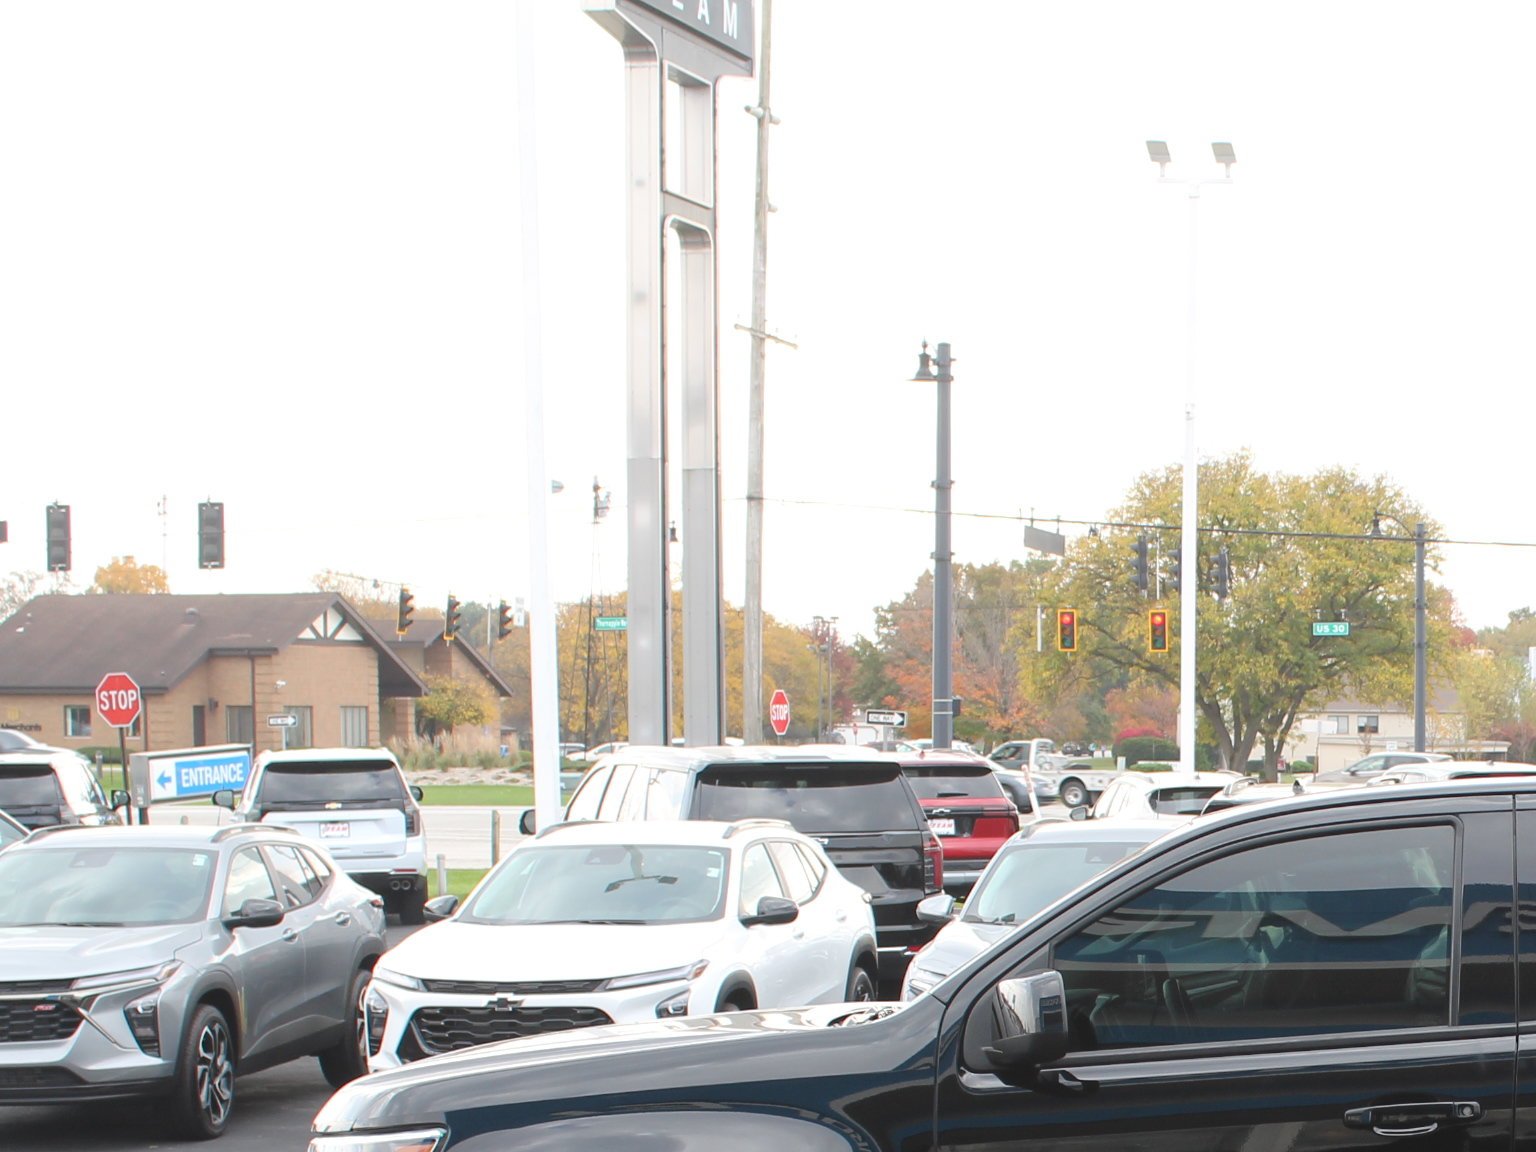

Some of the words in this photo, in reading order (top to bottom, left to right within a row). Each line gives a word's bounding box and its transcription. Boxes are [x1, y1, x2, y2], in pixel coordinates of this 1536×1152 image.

[672, 0, 738, 39] AM
[1316, 624, 1330, 633] US
[1332, 624, 1345, 633] 30
[100, 689, 137, 710] STOP
[772, 704, 788, 720] STOP
[181, 762, 244, 788] ENTRANCE
